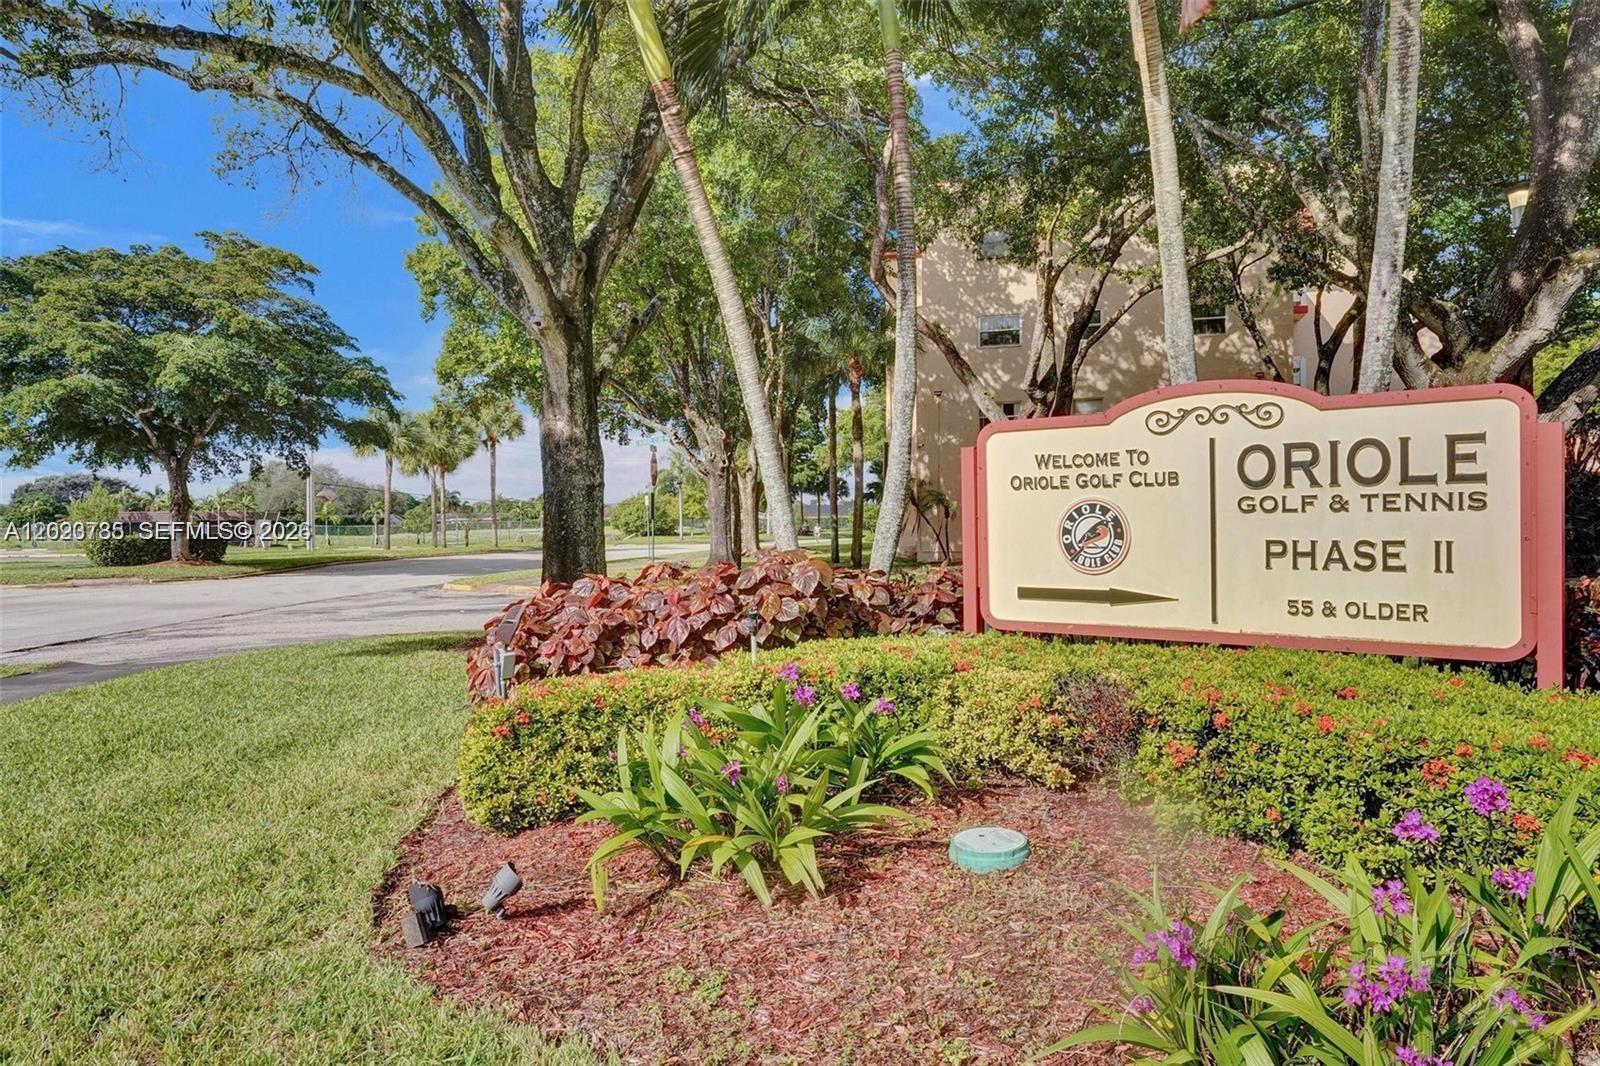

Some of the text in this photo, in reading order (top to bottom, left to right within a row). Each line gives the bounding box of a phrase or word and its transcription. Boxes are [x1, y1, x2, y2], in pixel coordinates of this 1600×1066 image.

[1237, 431, 1488, 490] ORIOLE
[1237, 491, 1488, 514] GOLF & TENNIS
[1063, 504, 1116, 543] ORIOLE
[1078, 539, 1123, 568] GOLF CLUB
[1265, 539, 1455, 574] PHASE II
[1287, 600, 1429, 622] 55 & OLDER
